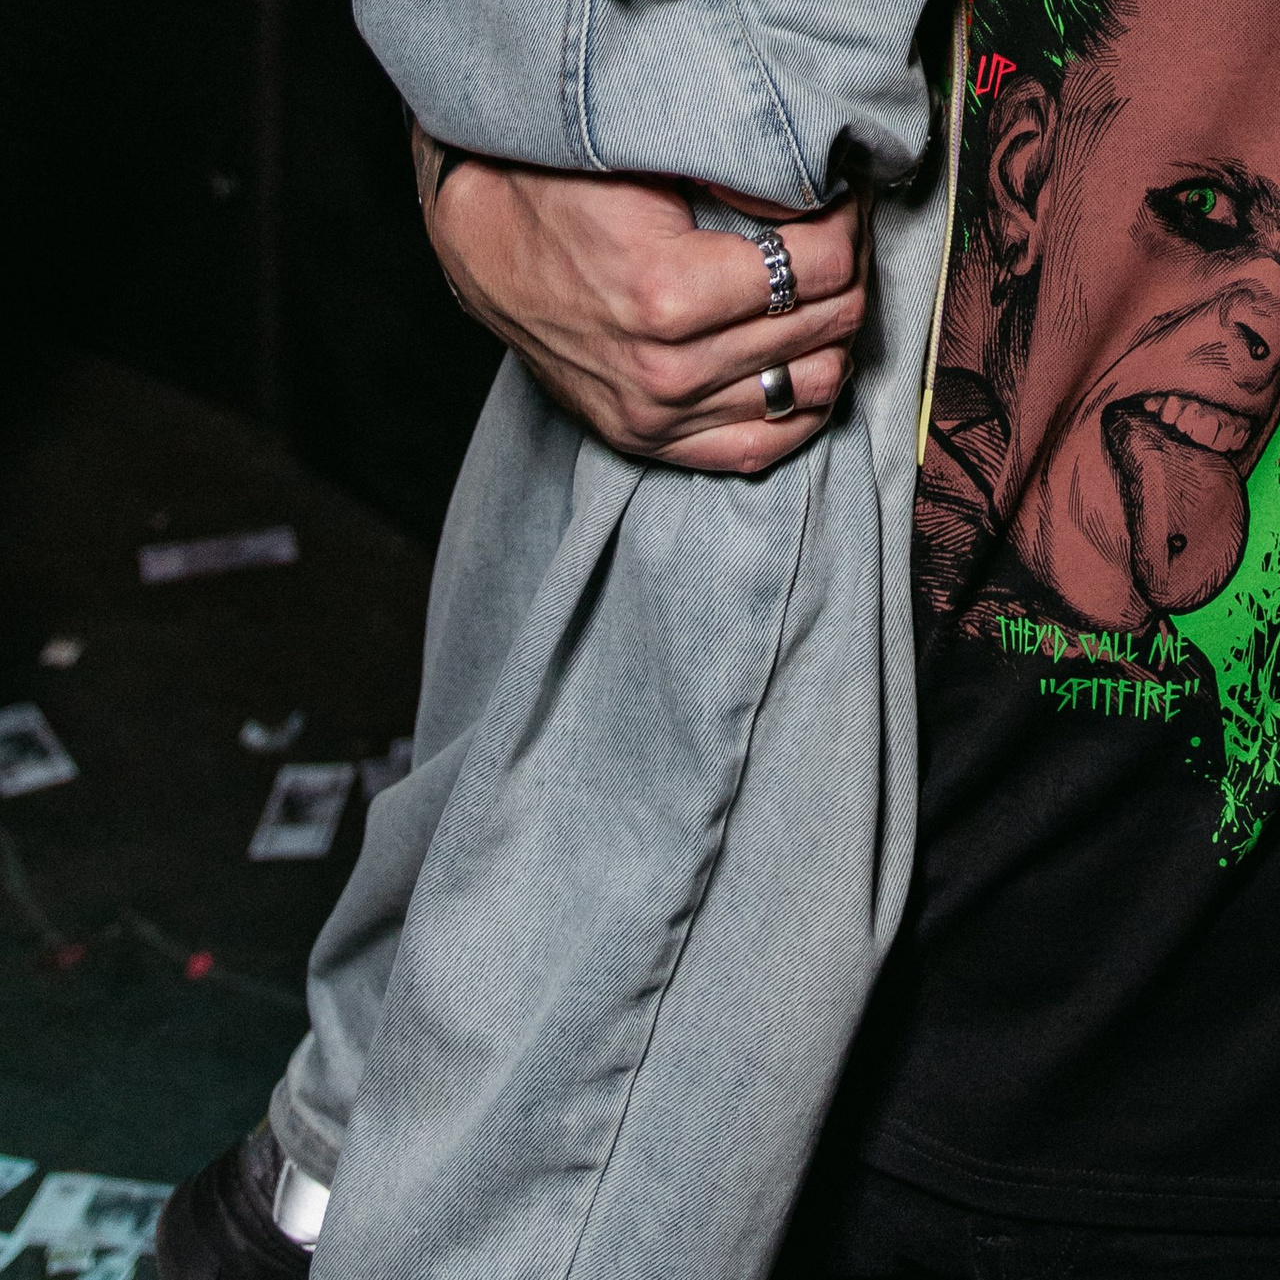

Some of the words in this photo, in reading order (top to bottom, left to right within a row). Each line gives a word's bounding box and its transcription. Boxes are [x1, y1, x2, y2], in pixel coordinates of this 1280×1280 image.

[975, 53, 1017, 99] UP
[996, 615, 1068, 664] THEY'D
[1078, 631, 1139, 664] CALL
[1149, 630, 1190, 666] ME
[1040, 678, 1200, 723] "SPITFIRE"
